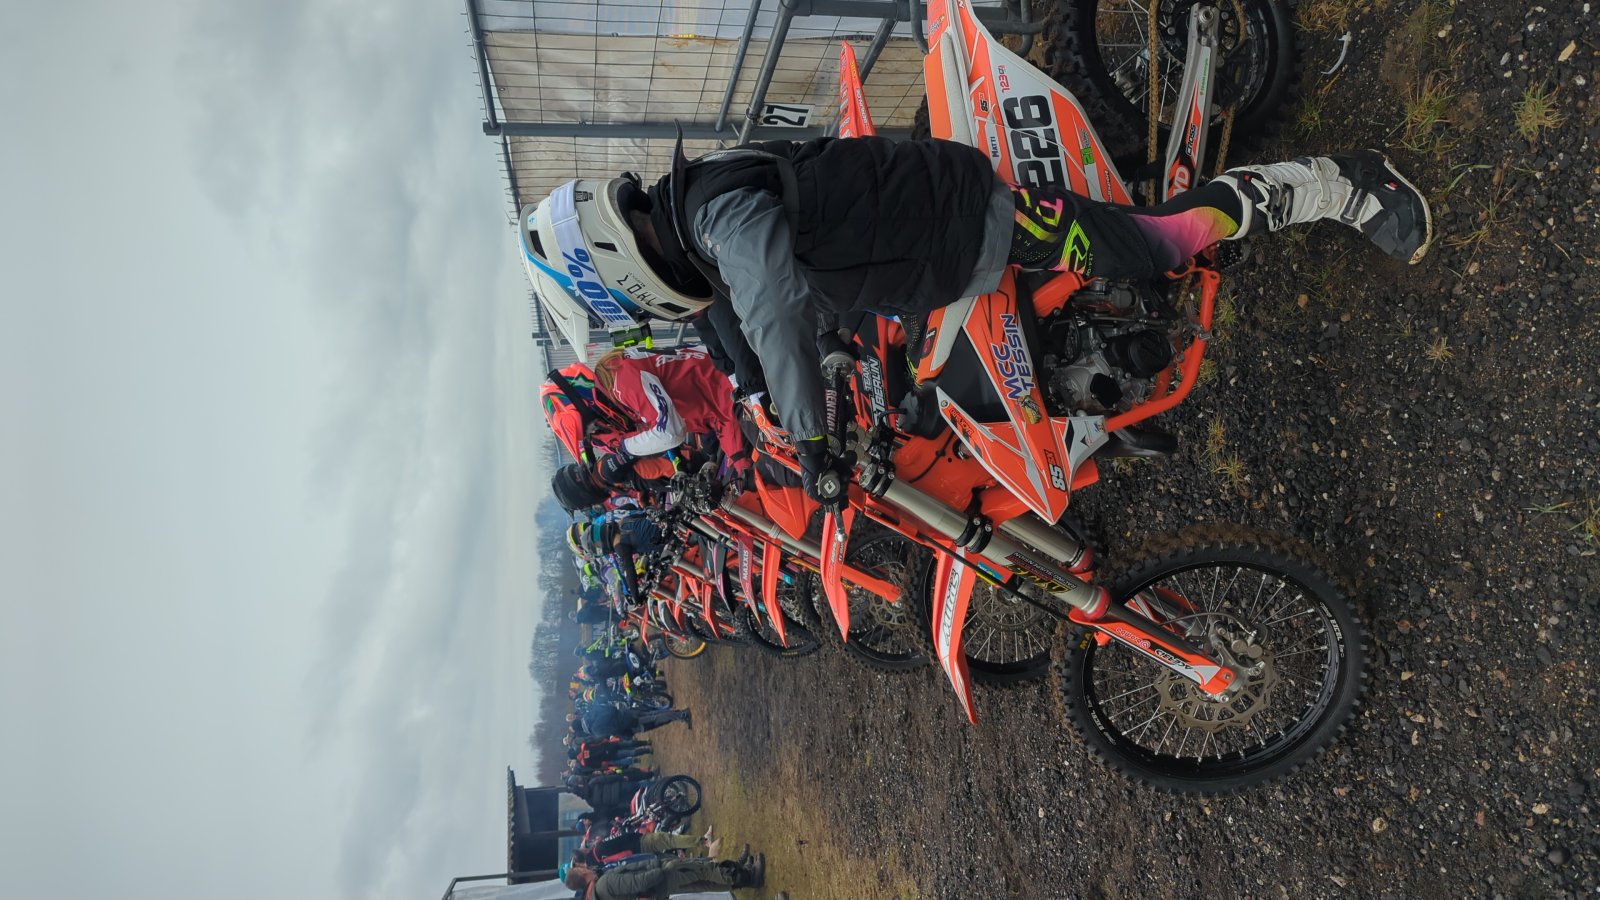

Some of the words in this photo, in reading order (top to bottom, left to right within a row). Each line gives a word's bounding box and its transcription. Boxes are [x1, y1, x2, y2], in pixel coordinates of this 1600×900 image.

[762, 104, 809, 126] 27
[1002, 94, 1065, 188] 226
[1186, 123, 1196, 156] CROSS
[562, 248, 631, 322] 100%
[861, 362, 872, 391] TEAM
[990, 342, 1023, 400] MCC
[1000, 314, 1034, 390] TESSIN
[866, 355, 885, 406] BERLIN
